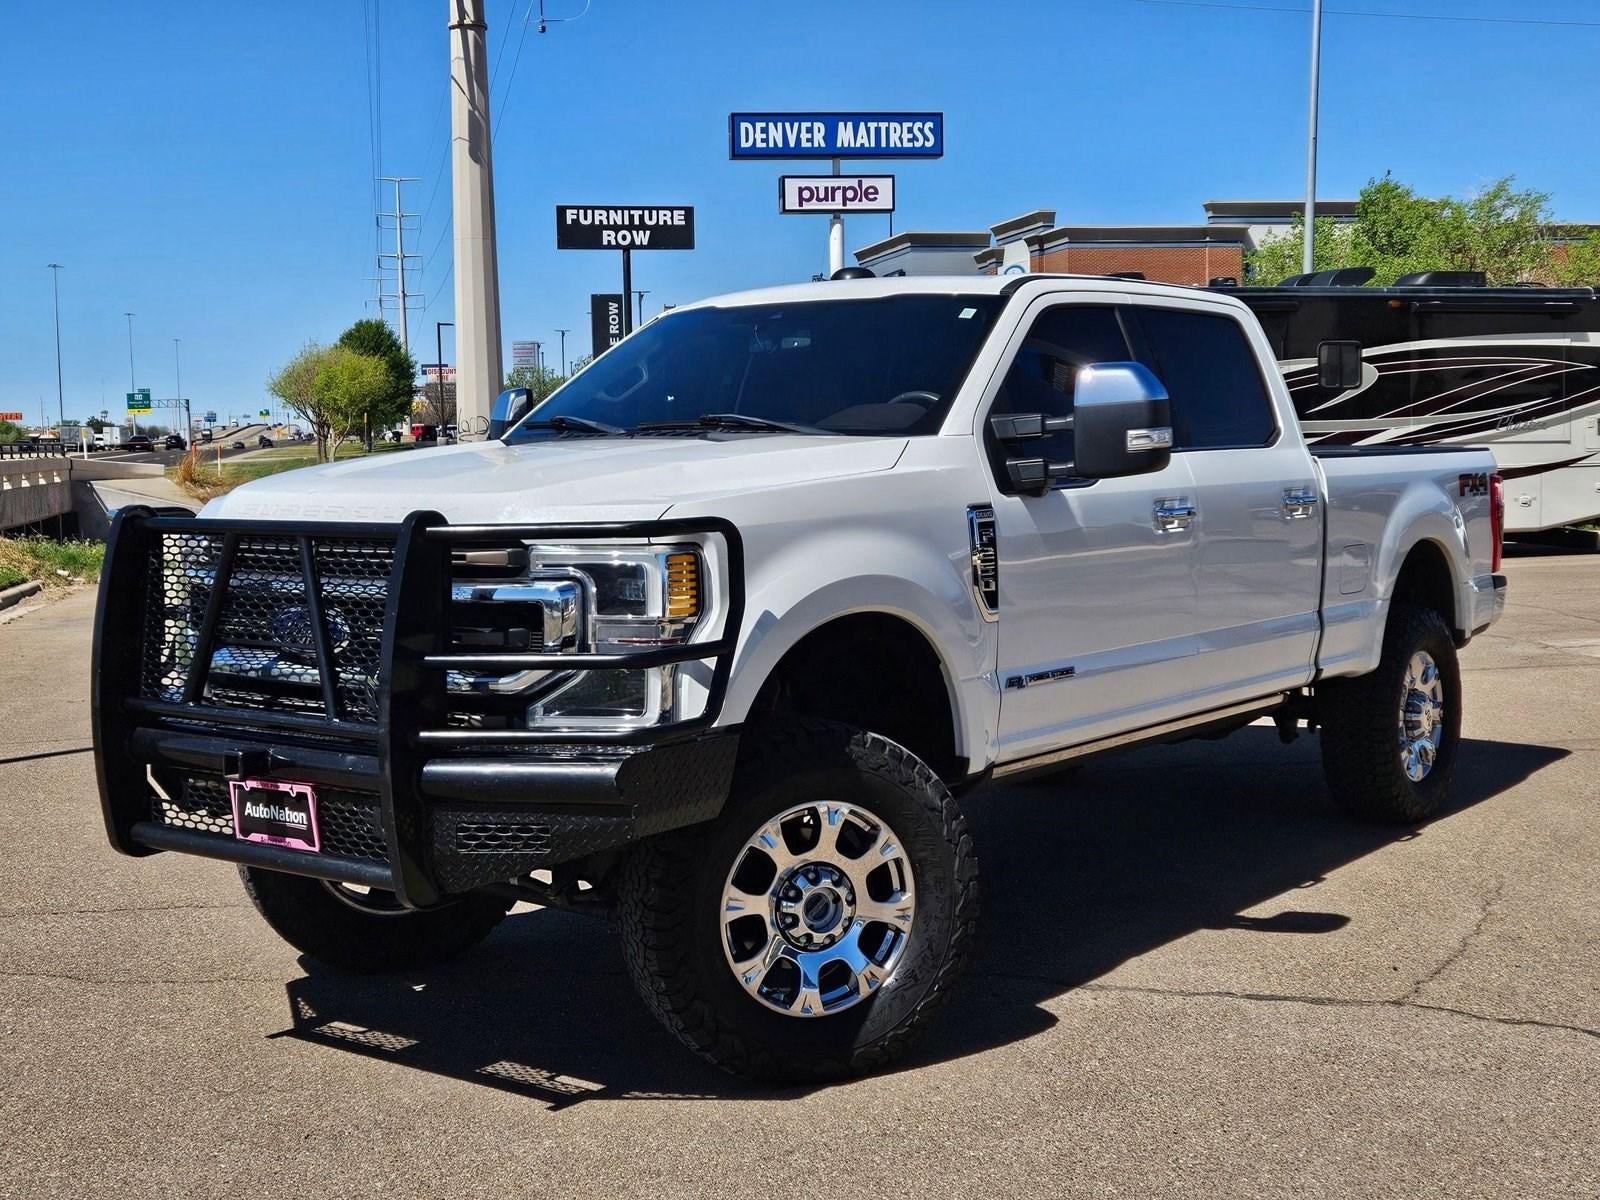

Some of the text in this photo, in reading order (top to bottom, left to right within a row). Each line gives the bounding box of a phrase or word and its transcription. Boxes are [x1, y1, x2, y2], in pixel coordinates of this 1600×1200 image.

[739, 121, 935, 148] DENVER MATTRESS
[797, 179, 880, 208] purple
[565, 209, 686, 226] FURNITURE
[602, 230, 651, 246] ROW
[608, 301, 620, 334] ROW
[1458, 472, 1488, 497] FX4
[244, 801, 308, 824] AutoNation
